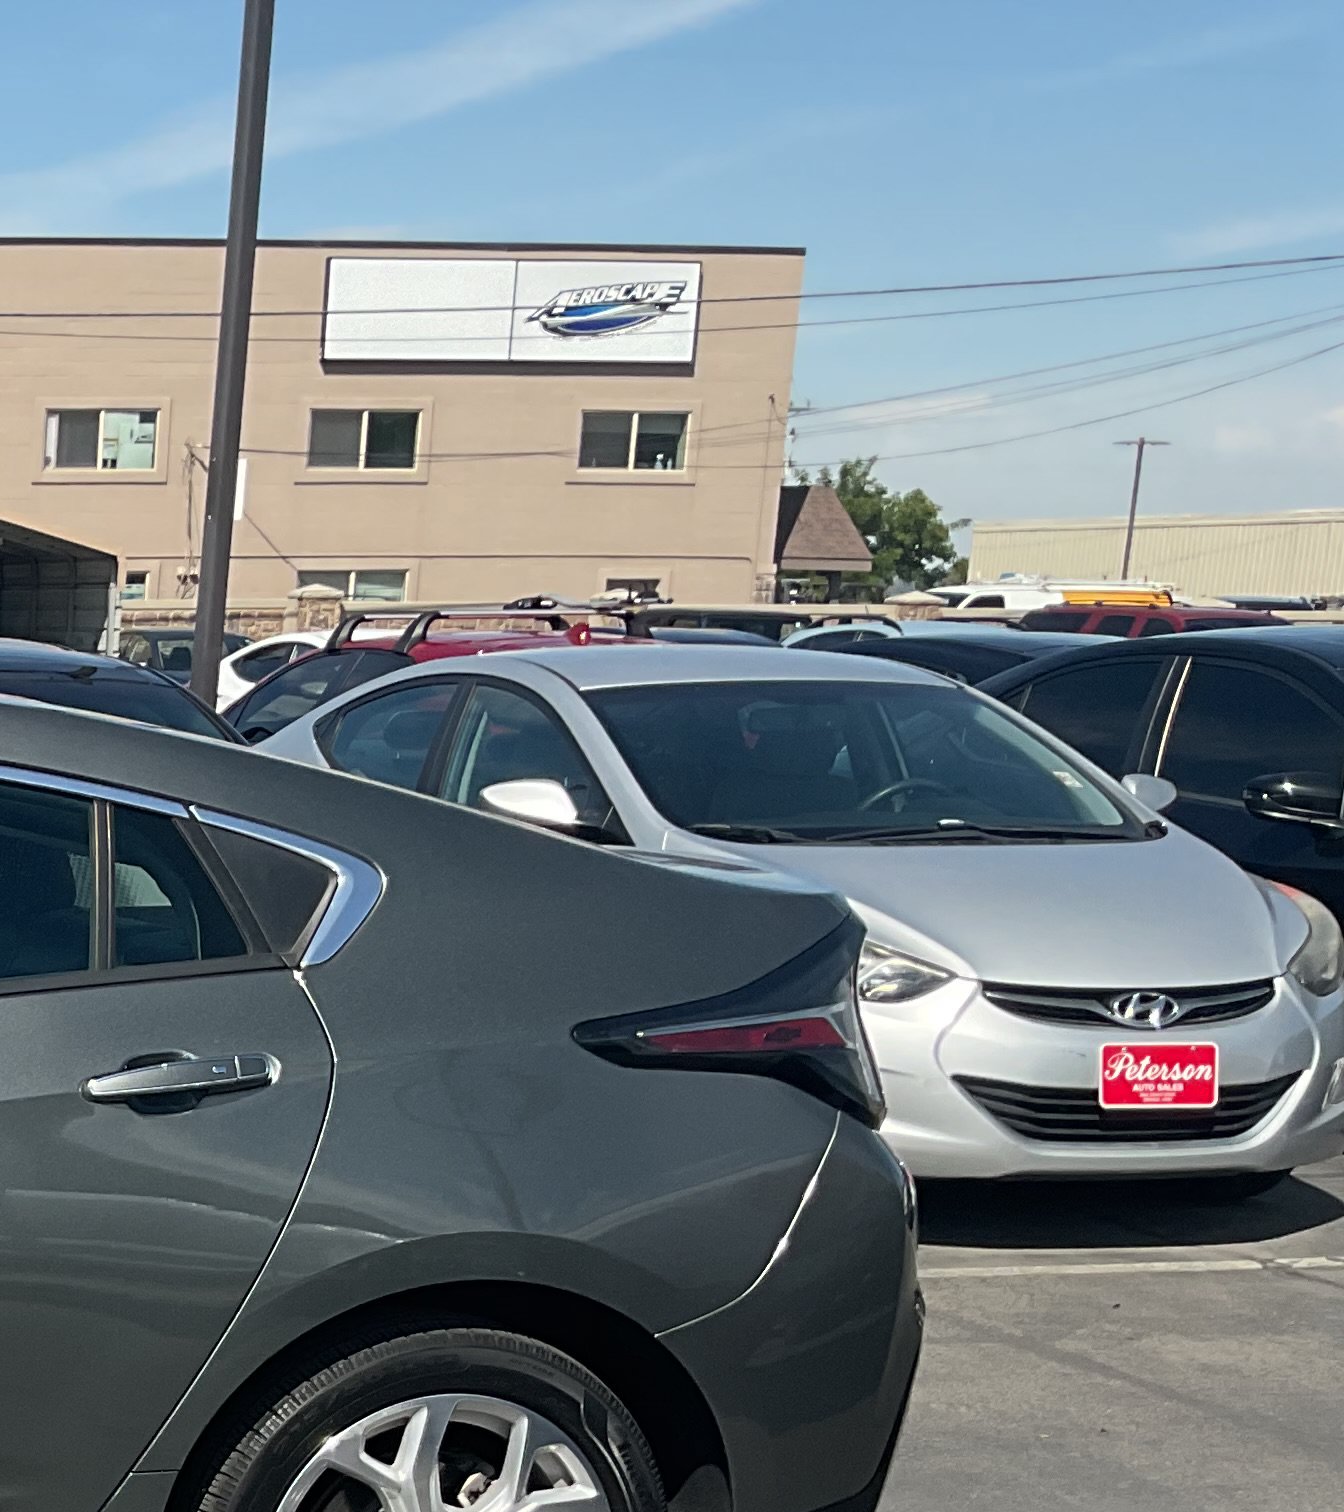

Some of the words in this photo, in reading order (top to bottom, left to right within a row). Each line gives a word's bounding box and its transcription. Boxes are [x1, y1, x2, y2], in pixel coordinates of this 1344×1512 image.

[525, 280, 688, 322] AEROSCAPE
[1104, 1052, 1213, 1081] Peterson
[1132, 1083, 1155, 1092] AUTO
[1156, 1083, 1185, 1092] SALES
